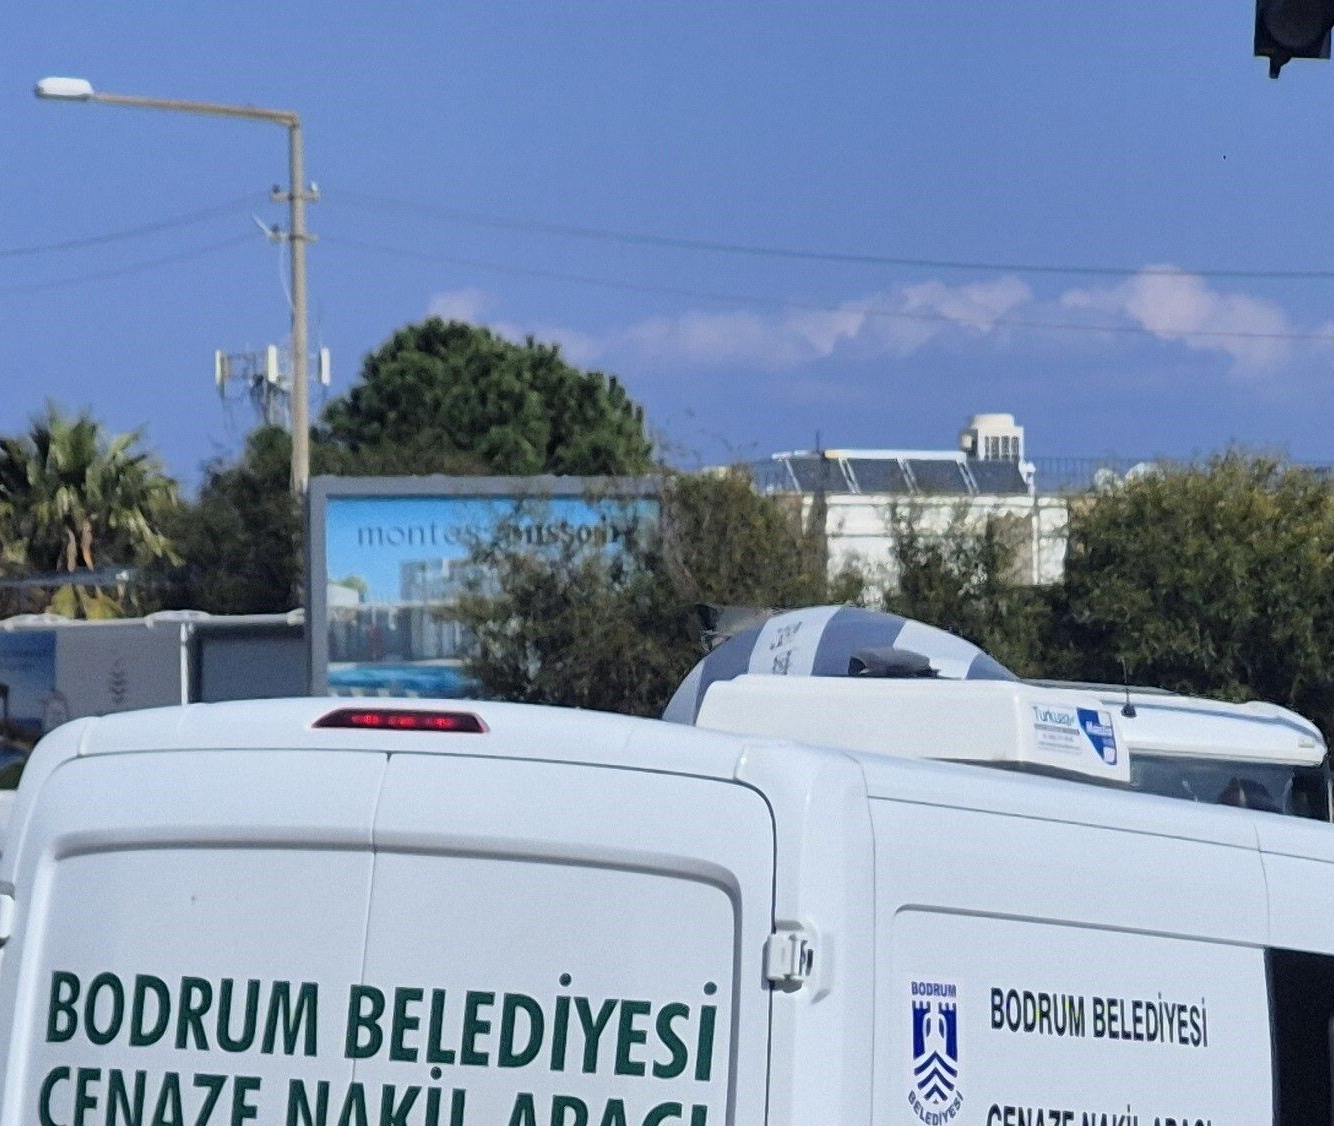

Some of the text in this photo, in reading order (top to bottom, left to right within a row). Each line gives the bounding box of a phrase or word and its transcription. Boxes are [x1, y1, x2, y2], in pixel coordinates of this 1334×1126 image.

[911, 981, 957, 997] BODRUM
[45, 970, 718, 1082] BODRUM BELEDİYESİ
[991, 987, 1208, 1048] BODRUM BELEDİYESİ
[908, 1090, 964, 1126] BELEDİYESİ
